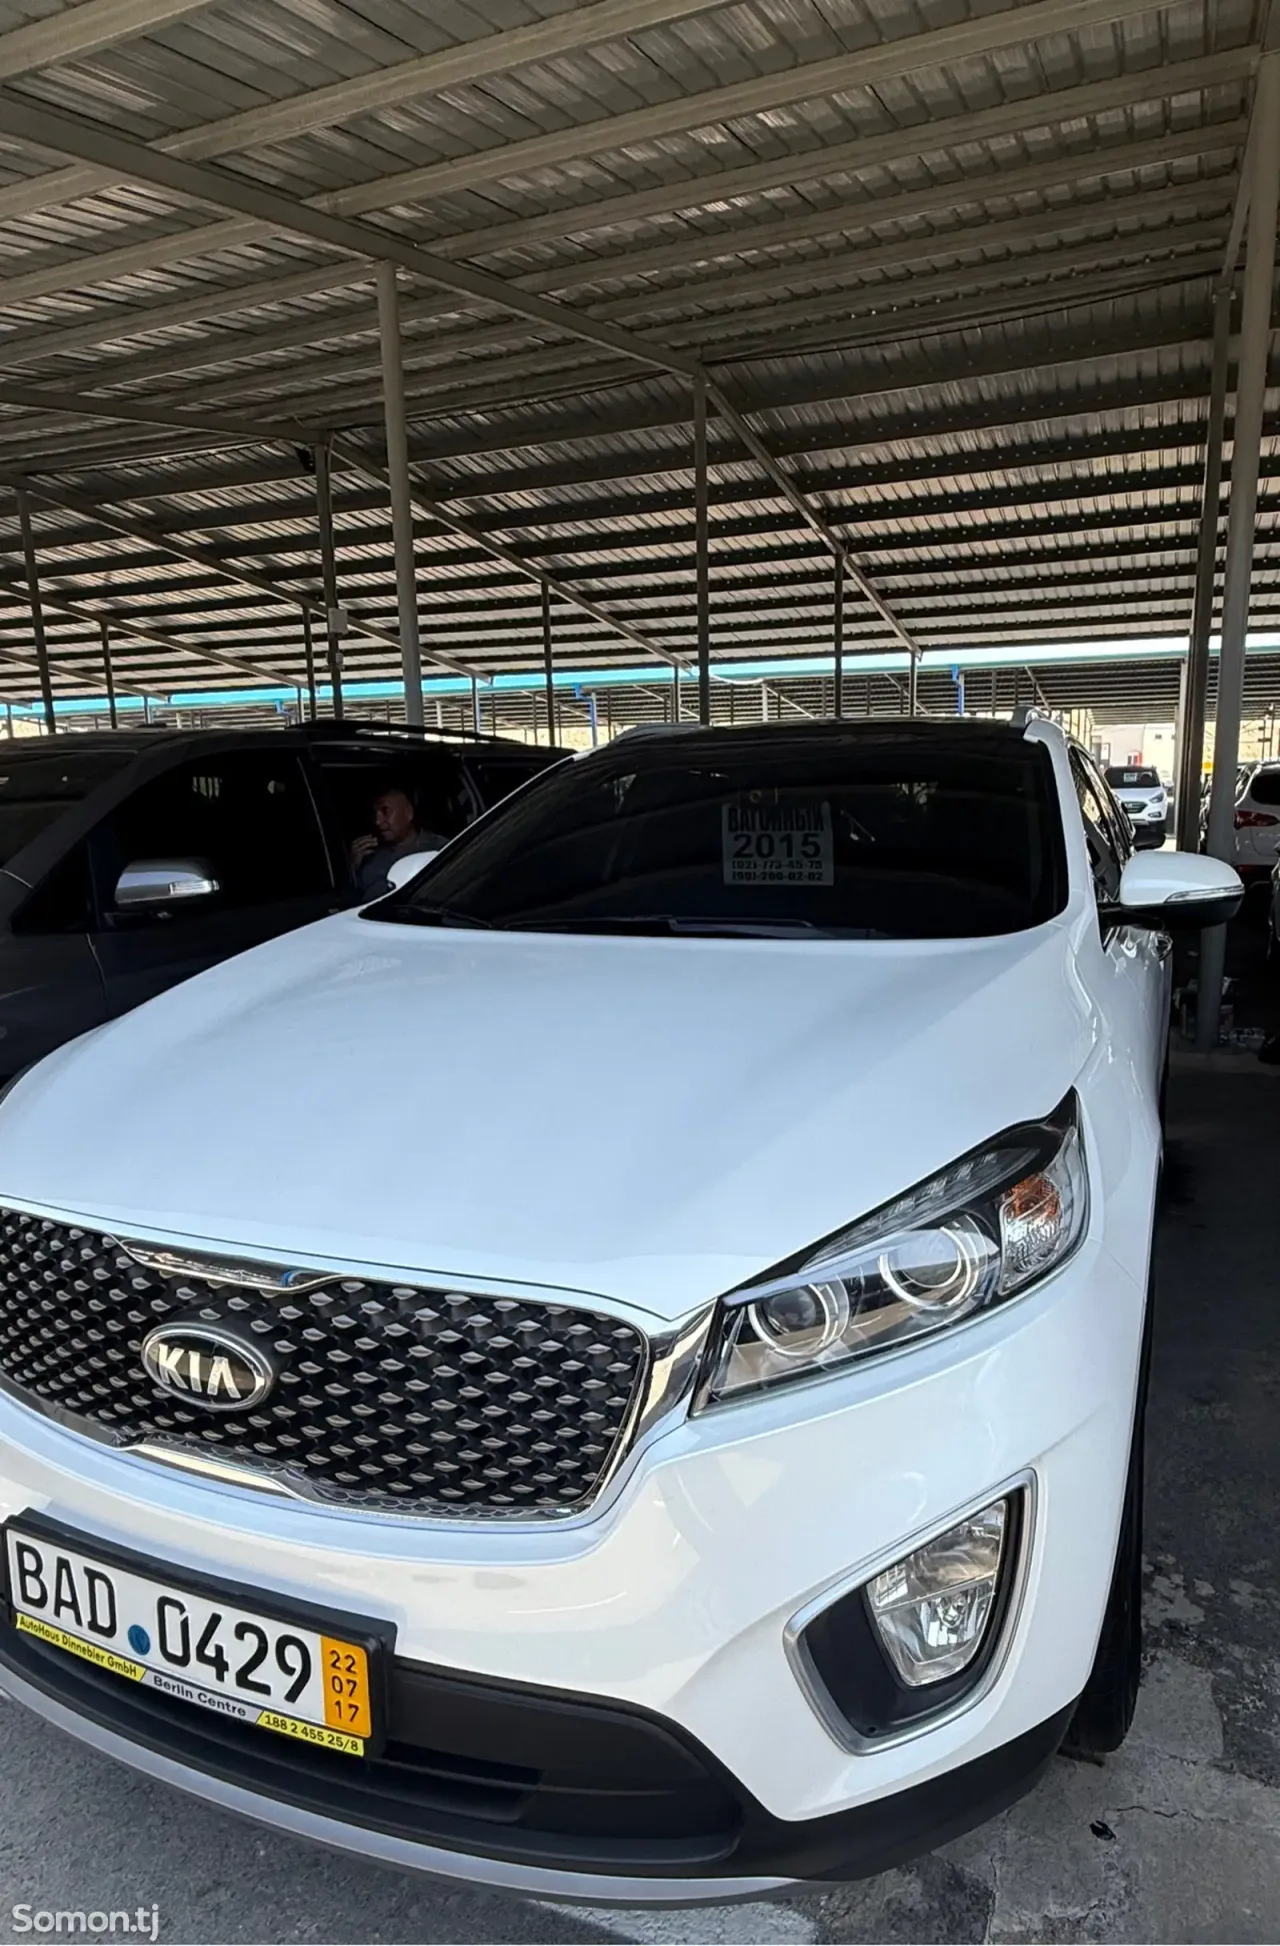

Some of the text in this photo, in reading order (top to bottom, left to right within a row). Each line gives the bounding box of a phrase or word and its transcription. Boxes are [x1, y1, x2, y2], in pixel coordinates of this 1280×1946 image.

[733, 832, 821, 859] 2015
[158, 1343, 242, 1399] KIA
[15, 1541, 312, 1703] BAD 0429
[19, 1616, 137, 1677] AutoHaus Dinnebier GmbH
[329, 1649, 357, 1674] 22
[153, 1675, 246, 1716] Berlin Centre
[331, 1675, 358, 1697] 07
[334, 1700, 359, 1722] 17
[265, 1714, 359, 1752] 188 2 455 25/8
